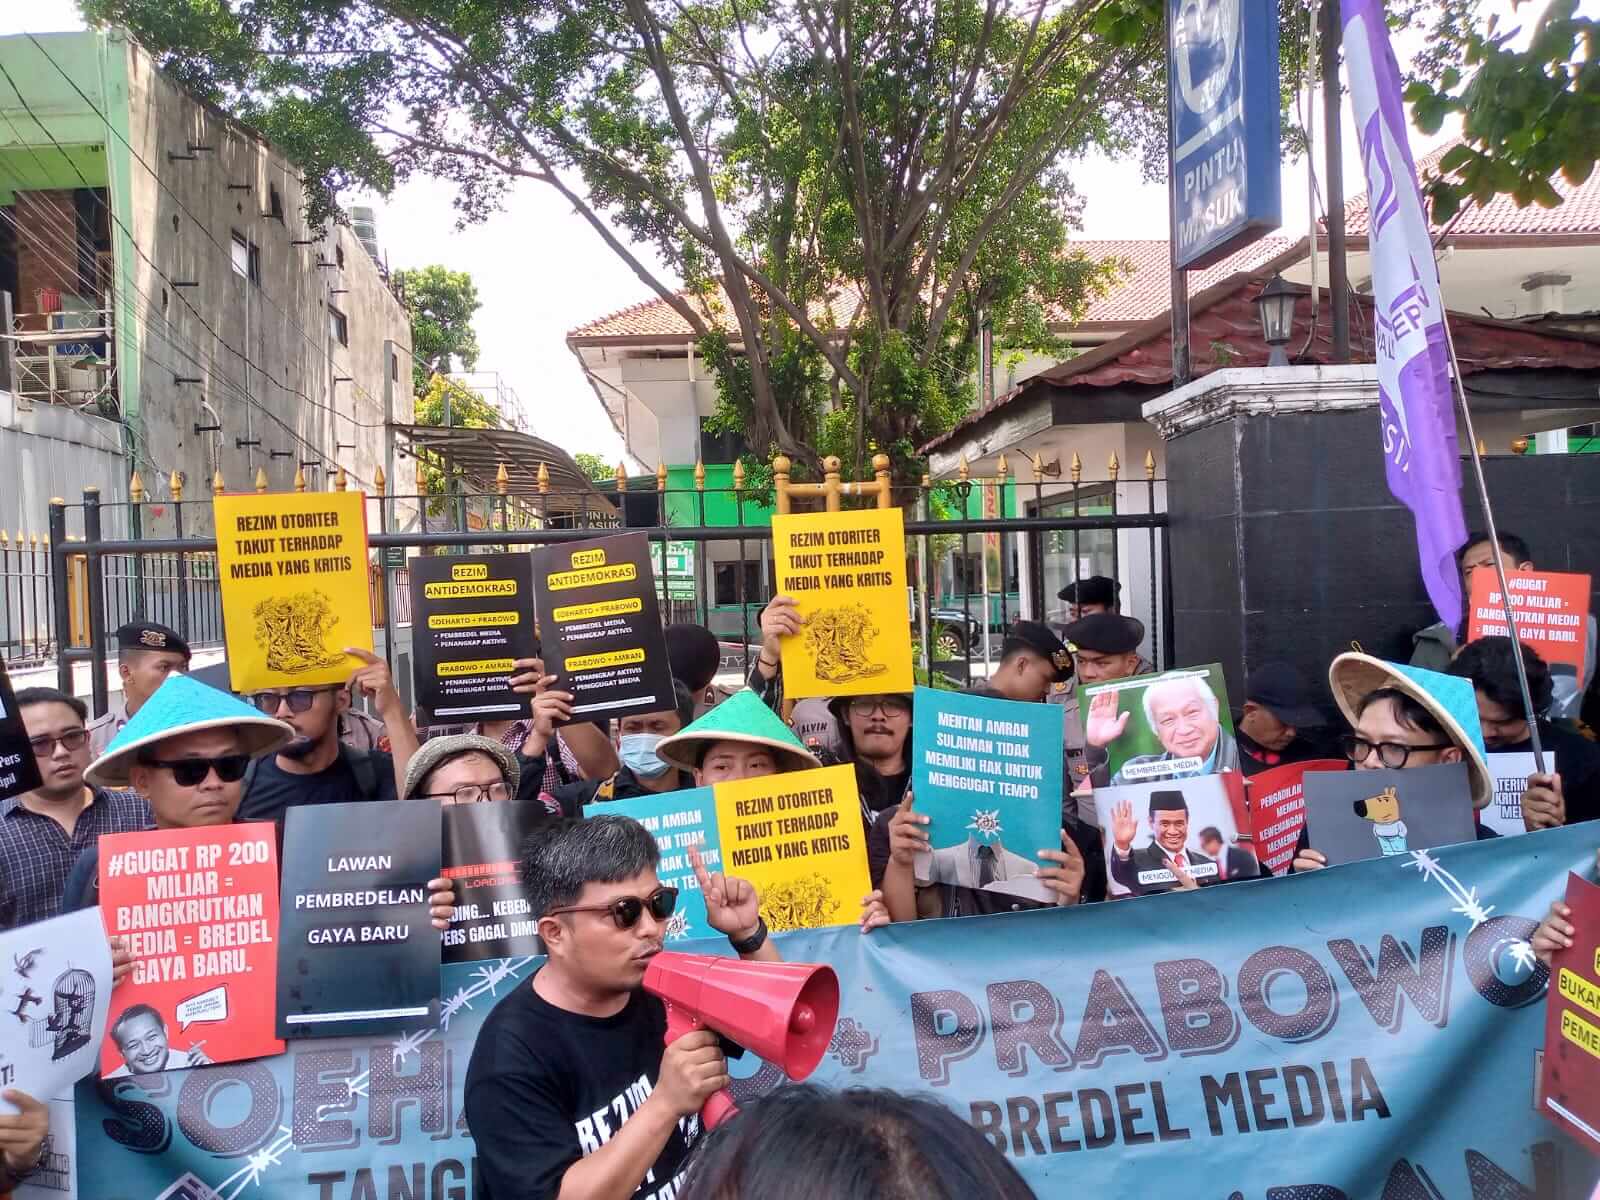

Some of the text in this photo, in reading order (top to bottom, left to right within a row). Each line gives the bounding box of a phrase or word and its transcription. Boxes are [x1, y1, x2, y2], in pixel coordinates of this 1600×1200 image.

[1184, 138, 1239, 202] PINTU
[1179, 189, 1242, 250] MASUK
[237, 511, 338, 532] REZIM OTORITER
[235, 534, 343, 555] TAKUT TERHADAP
[790, 529, 880, 547] REZIM OTORITER
[230, 556, 351, 579] MEDIA YANG KRITIS
[573, 553, 604, 565] REZIM
[789, 551, 884, 569] TAKUT TERHADAP
[453, 567, 486, 577] REZIM
[549, 568, 634, 586] ANTIDEMOKRASI
[784, 572, 892, 591] MEDIA YANG KRITIS
[426, 583, 515, 595] ANTIDEMOKRASI
[1508, 578, 1548, 592] #GUGAT
[600, 601, 639, 612] PRABOWO
[1507, 594, 1524, 606] 00
[1526, 595, 1561, 609] MILIAR
[1477, 608, 1580, 626] BANGKUTKAN MEDIA
[1520, 627, 1546, 640] GAYA
[440, 664, 478, 673] PRABOWO
[938, 712, 1029, 738] MENTAN AMRAN
[936, 732, 1030, 758] SULAIMAN TIDAK
[925, 750, 1043, 780] MEMILIKI HAK UNTUK
[1125, 759, 1199, 776] MEMBREDEL MEDIA
[928, 771, 1039, 799] MENGGUGAT TEMPO
[735, 788, 833, 817] REZIM OTORITER
[1260, 784, 1302, 809] PENGADILAN
[662, 809, 702, 829] AMRAN
[735, 811, 839, 841] TAKUT TERHADAP
[108, 841, 269, 877] #GUGAT RP 200
[732, 834, 850, 867] MEDIA YANG KRITIS
[328, 855, 391, 872] LAWAN
[661, 855, 683, 873] HAK
[147, 871, 218, 900] MILIAR
[295, 889, 423, 909] PEMBREDELAN
[117, 893, 263, 931] BANGKRUTKAN
[199, 919, 272, 949] BREDEL
[308, 925, 409, 944] GAYA BARU
[469, 923, 509, 943] GAGAL
[132, 948, 253, 985] GAYA BARU.
[911, 915, 1550, 1086] PRABOWO
[1200, 1058, 1392, 1137] MEDIA
